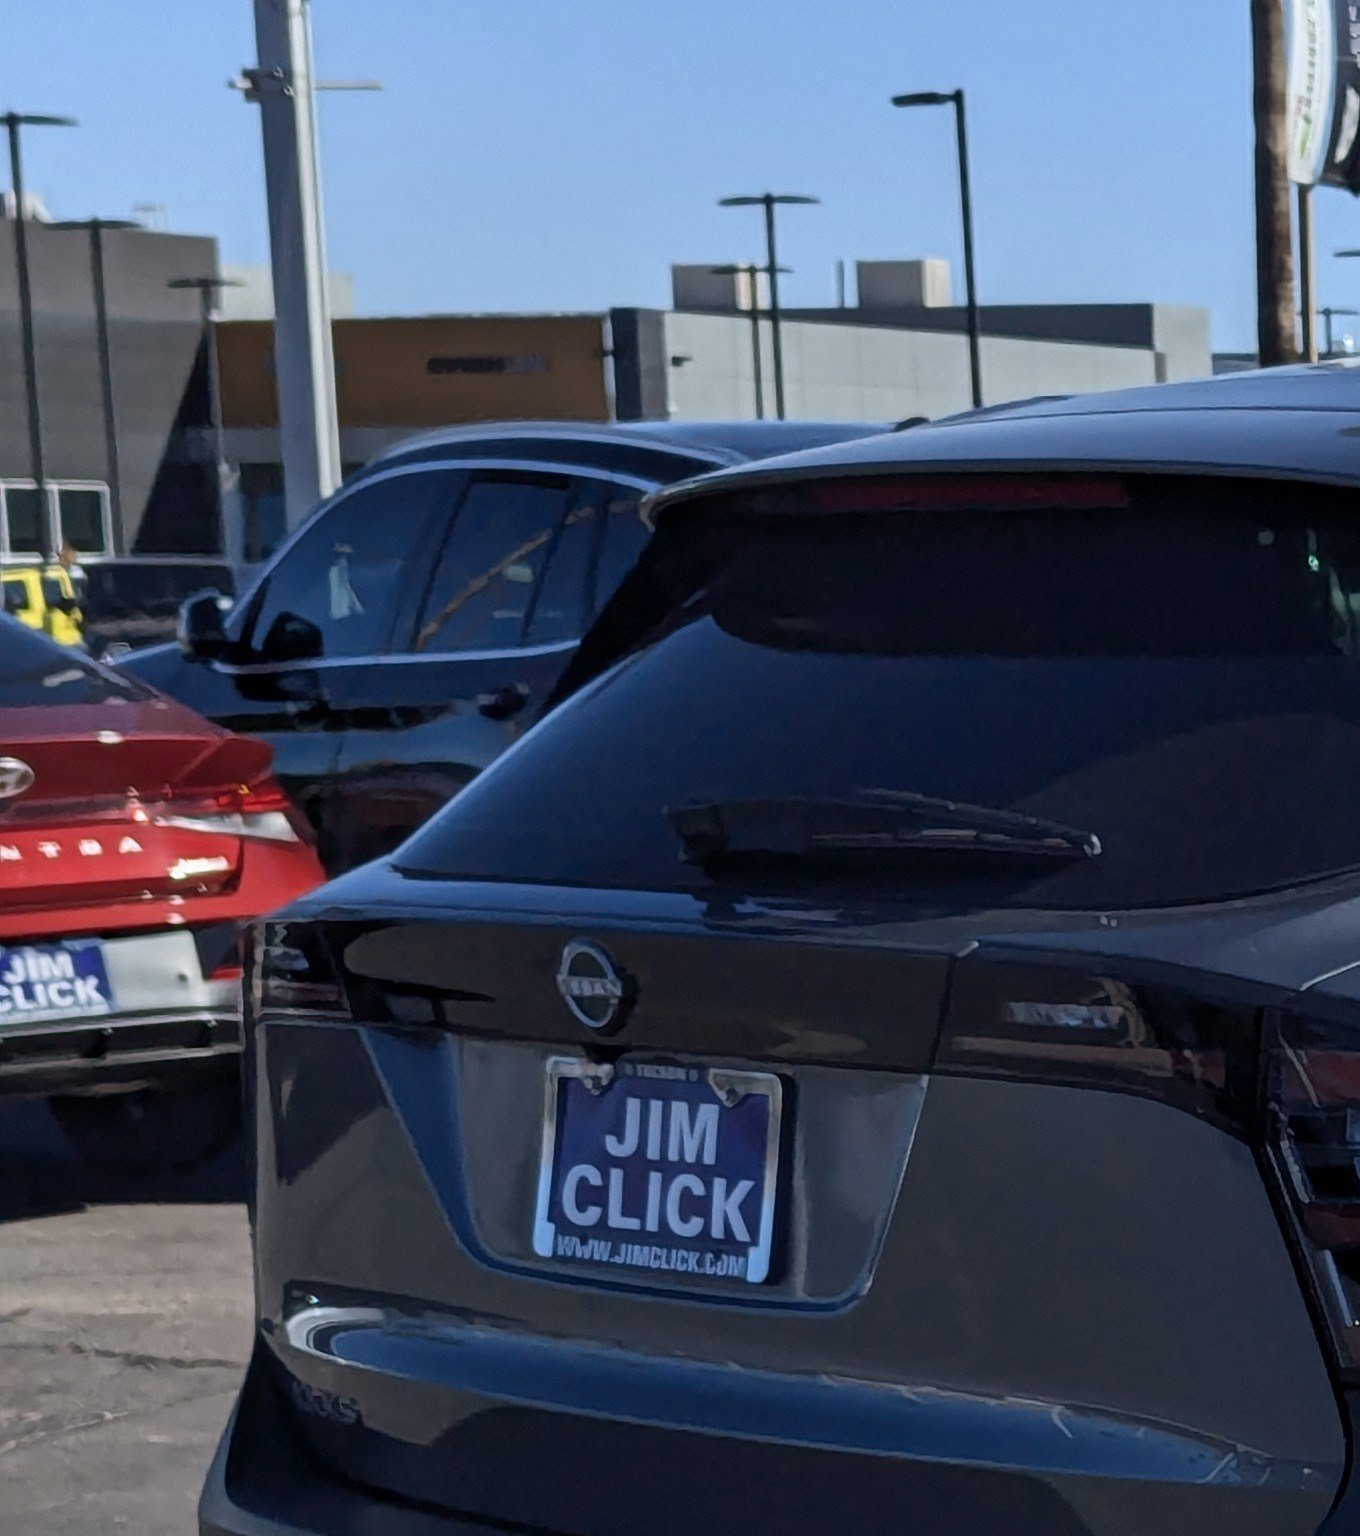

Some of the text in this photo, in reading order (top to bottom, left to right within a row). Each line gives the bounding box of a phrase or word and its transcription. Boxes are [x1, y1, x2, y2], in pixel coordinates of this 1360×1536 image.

[2, 949, 74, 984] JIM
[605, 1097, 720, 1165] JIM
[562, 1164, 755, 1242] CLICK
